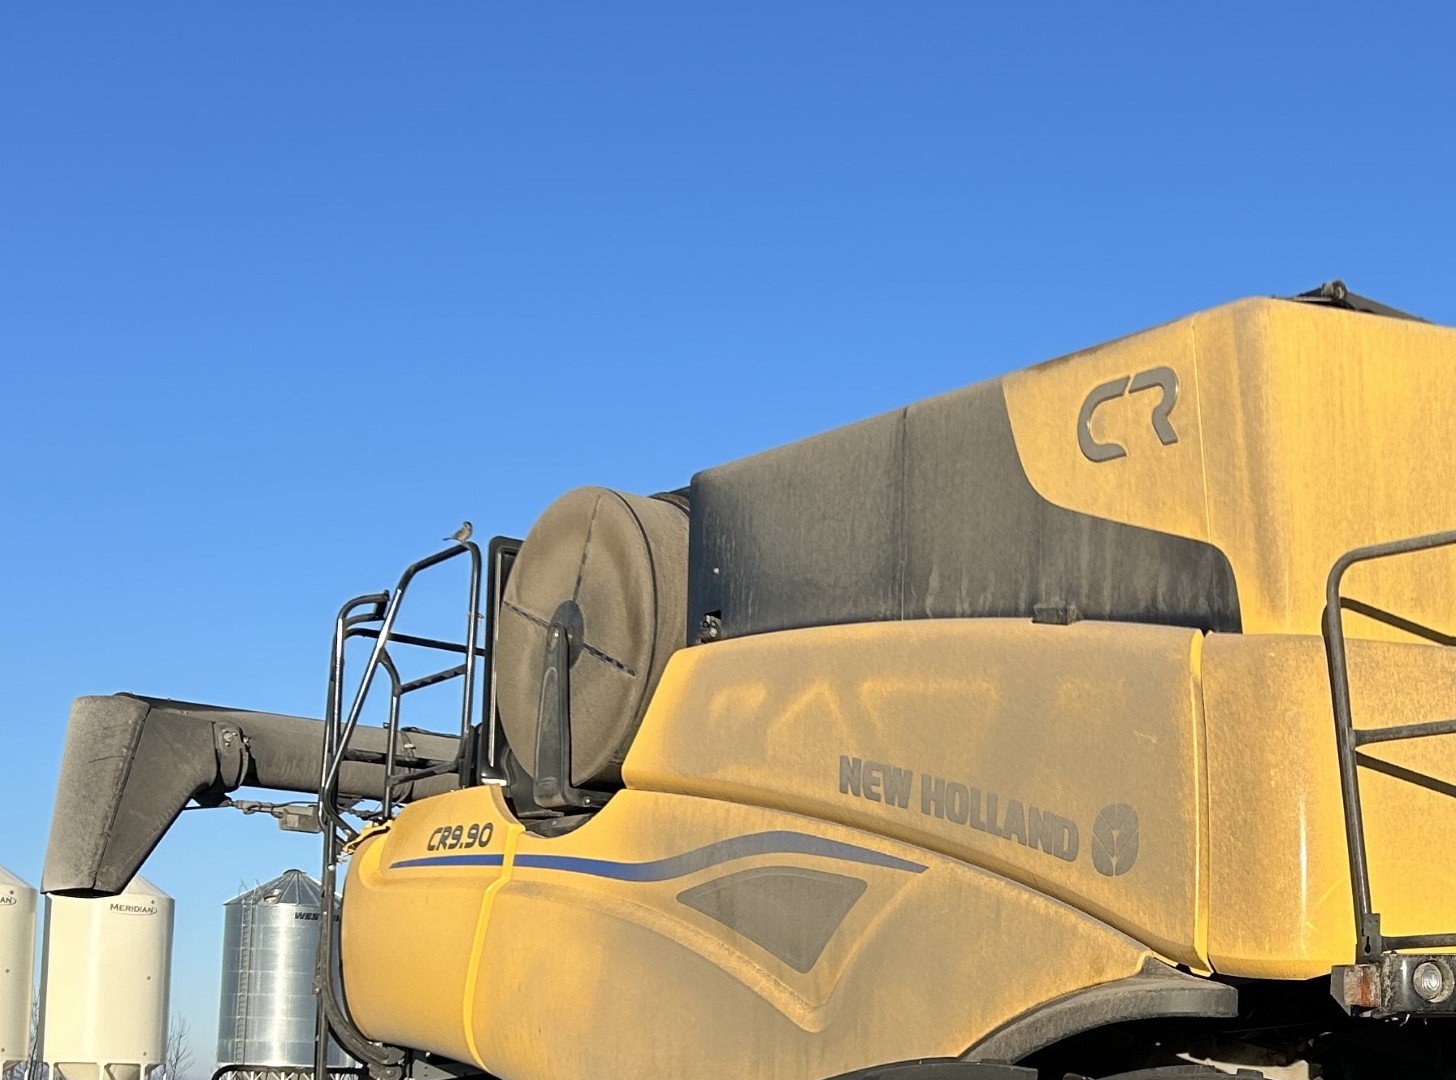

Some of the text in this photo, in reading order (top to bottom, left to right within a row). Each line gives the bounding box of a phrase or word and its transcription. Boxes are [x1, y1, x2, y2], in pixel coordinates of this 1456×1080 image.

[1077, 366, 1179, 463] CR
[427, 822, 493, 851] CR9.90
[839, 755, 1079, 862] NEW HOLLAND
[110, 903, 154, 914] MERIDIAN
